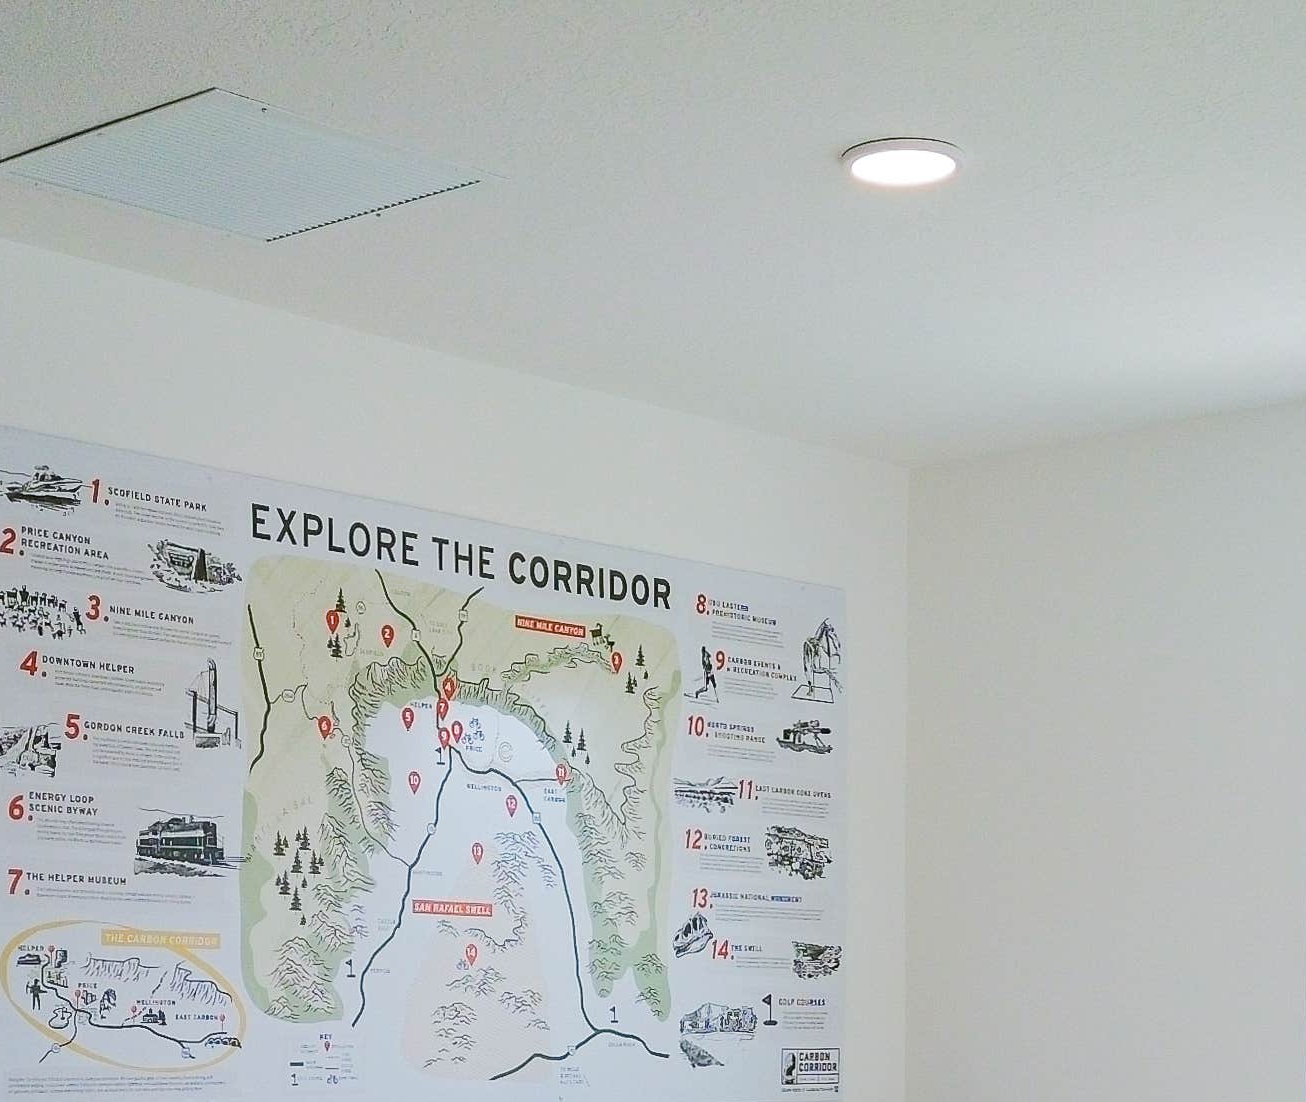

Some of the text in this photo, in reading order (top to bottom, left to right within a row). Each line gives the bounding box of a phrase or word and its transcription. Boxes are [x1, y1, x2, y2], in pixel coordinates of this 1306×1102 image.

[108, 487, 151, 502] SCOFIELD
[154, 496, 181, 508] STATE
[184, 500, 207, 512] PARK
[22, 526, 49, 539] PRICE
[52, 531, 91, 545] CANYON
[22, 538, 110, 560] RECREATION AREA
[251, 502, 420, 568] EXPLORE
[432, 536, 495, 580] THE
[509, 552, 672, 610] CORRIDOR
[110, 605, 131, 616] NINE
[134, 609, 156, 620] MILE
[158, 612, 194, 625] CANYON
[42, 655, 96, 669] DOWNTOWN
[99, 662, 134, 674] HELPER
[84, 720, 122, 733] GORDON
[126, 725, 154, 736] CREEK
[158, 728, 184, 740] FALLS
[410, 776, 418, 786] 10
[29, 791, 67, 802] ENERGY
[70, 794, 94, 804] LOOP
[29, 803, 98, 816] SCENIC BYWAY
[26, 872, 44, 882] THE
[48, 874, 85, 884] HELPER
[88, 875, 127, 886] MUSEUM
[414, 902, 491, 915] SAN RAFAEL SWELL
[105, 932, 218, 946] THE CARBON CORRIDOR
[799, 1052, 830, 1062] CARBON
[798, 1062, 837, 1072] CORRIDOR
